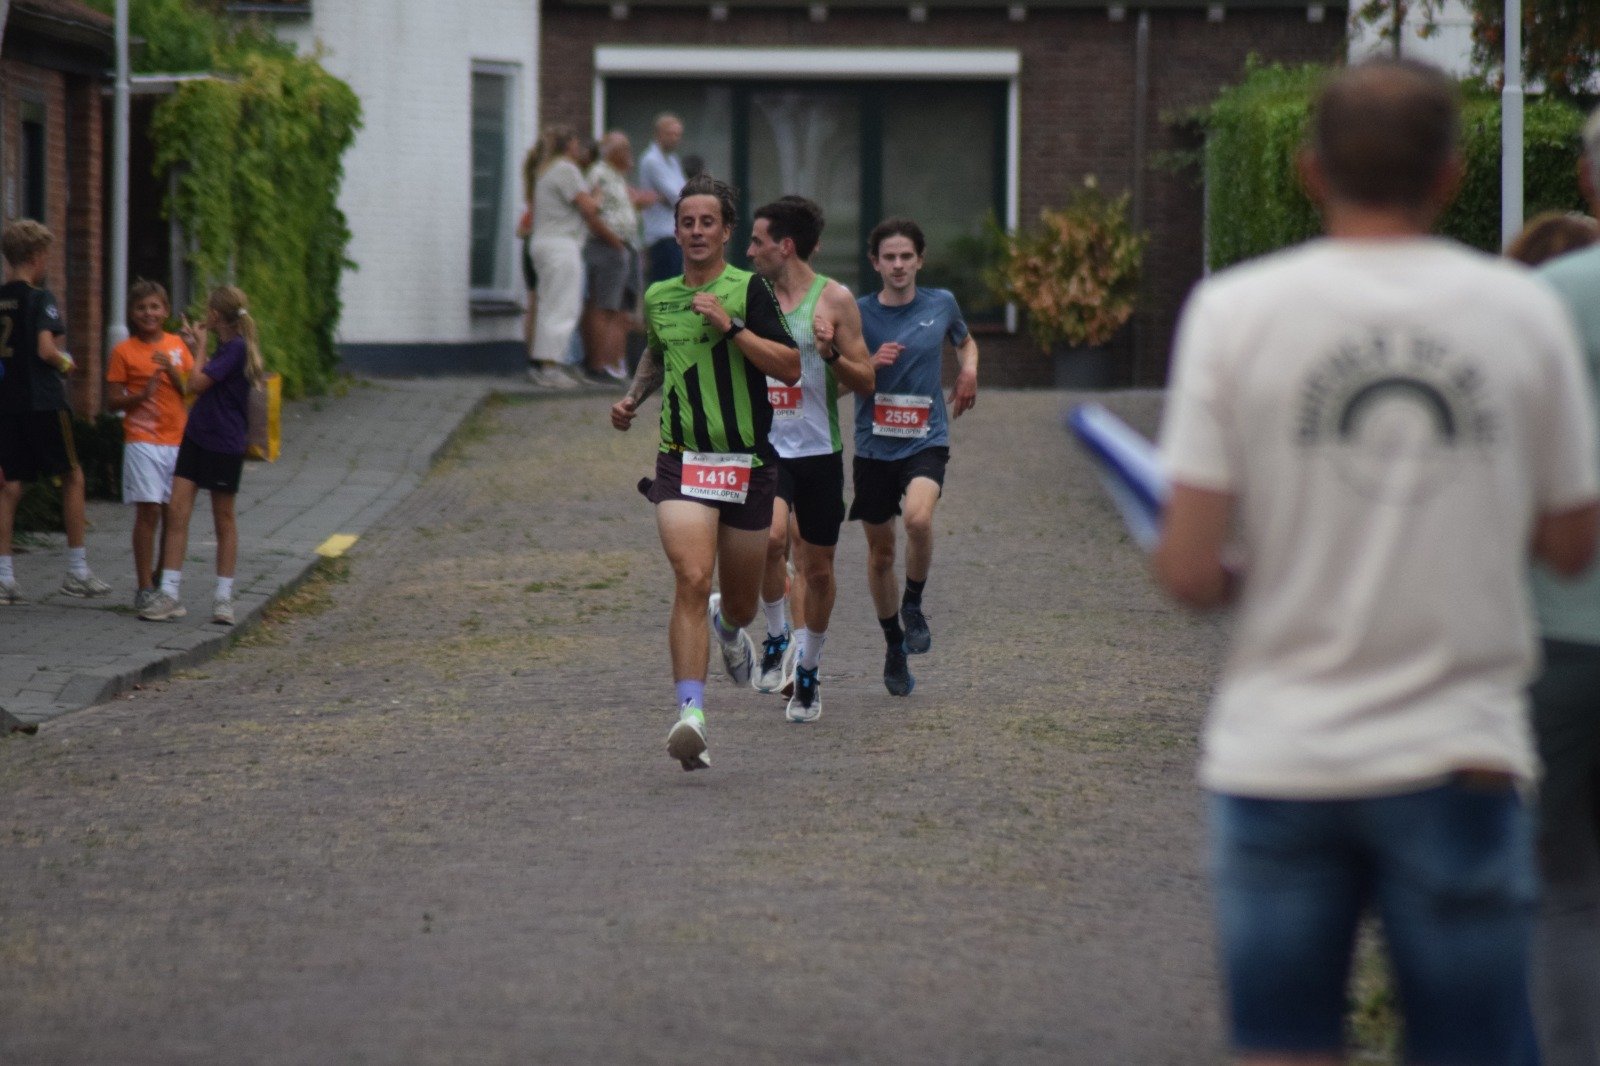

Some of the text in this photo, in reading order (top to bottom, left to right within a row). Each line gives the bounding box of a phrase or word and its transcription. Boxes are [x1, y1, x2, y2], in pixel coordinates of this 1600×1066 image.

[885, 409, 919, 425] 2556
[696, 470, 737, 486] 1416
[689, 487, 740, 499] ZOMERLOPEN
